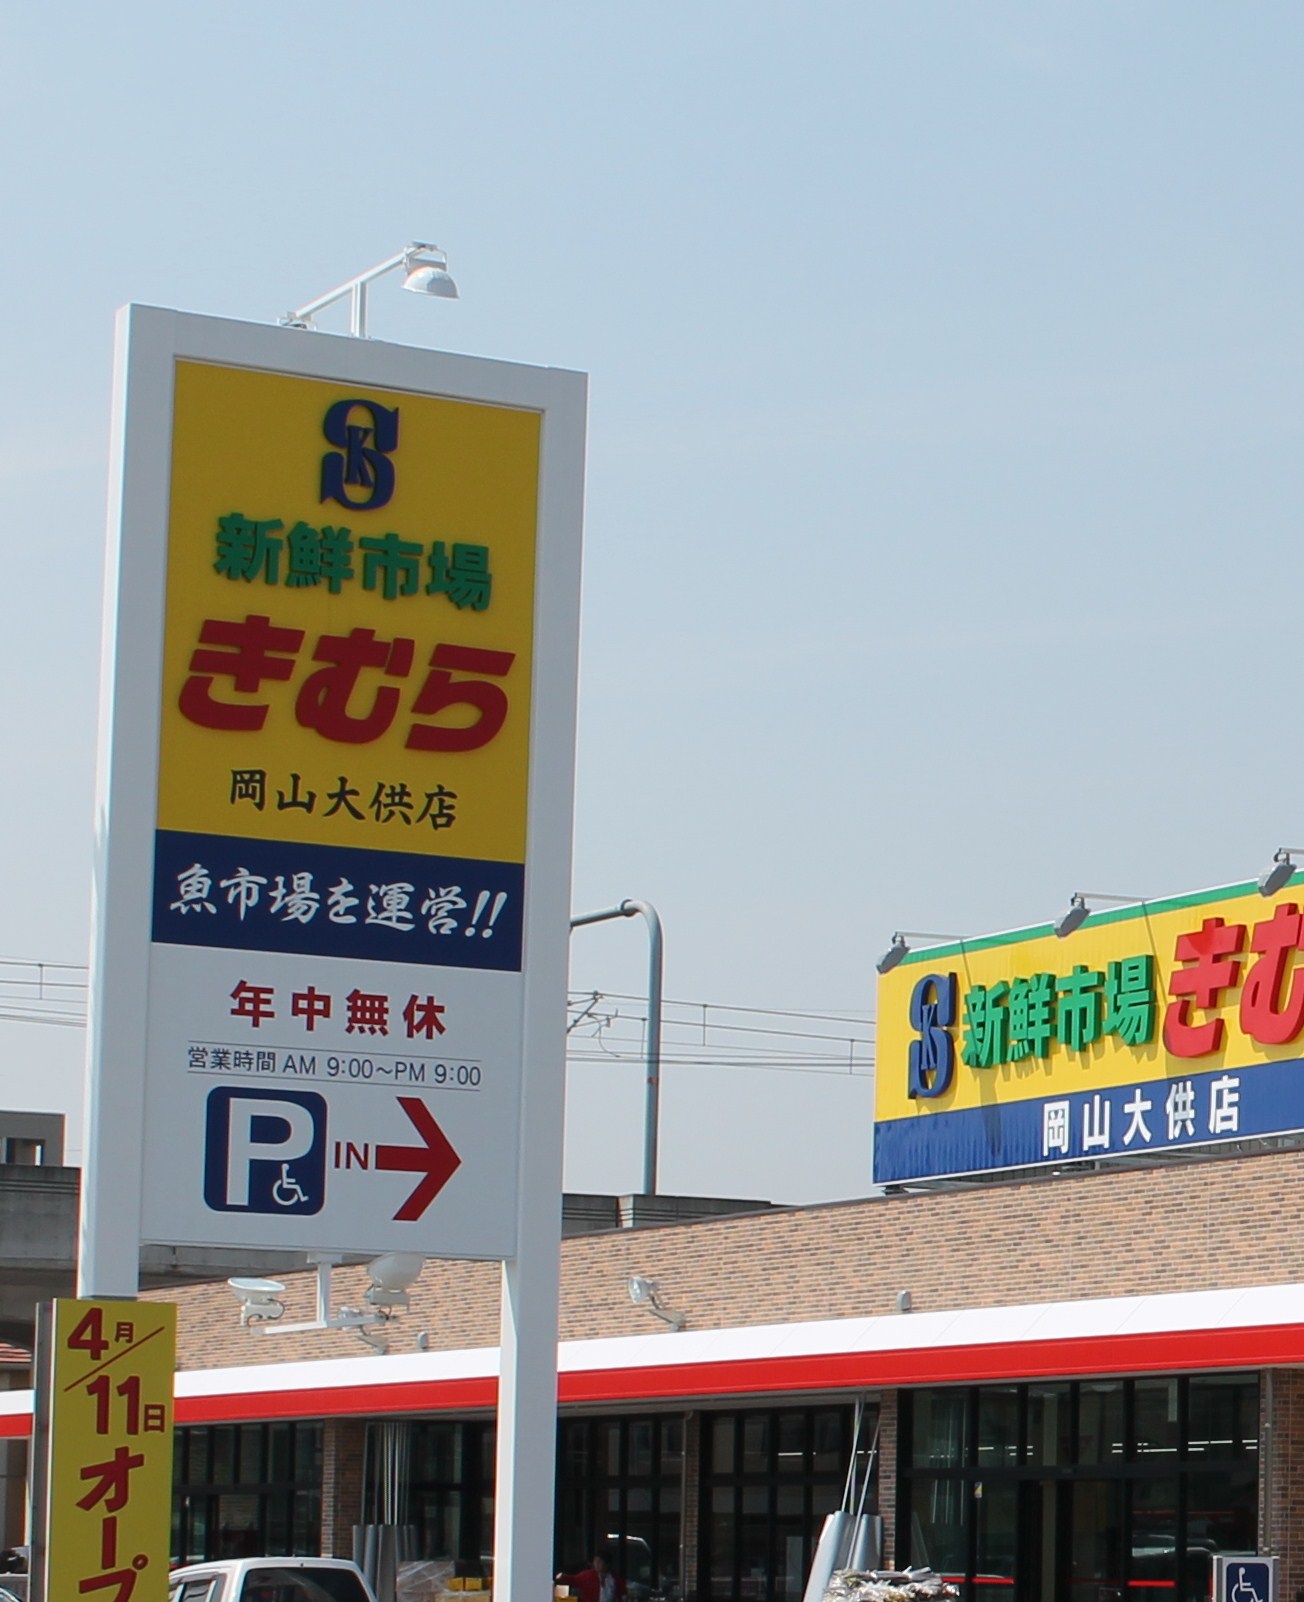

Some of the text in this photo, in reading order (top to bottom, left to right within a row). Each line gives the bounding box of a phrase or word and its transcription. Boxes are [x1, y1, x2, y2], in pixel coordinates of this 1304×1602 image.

[213, 512, 493, 612] 新鮮市場
[178, 614, 516, 753] きむら
[229, 768, 459, 831] 岡山大供店
[229, 980, 447, 1040] 年中無休
[960, 954, 1157, 1070] 新鮮市場
[187, 1046, 277, 1073] 営業時間
[282, 1055, 317, 1075] AM
[434, 1064, 482, 1086] 9:00
[1042, 1074, 1242, 1157] 岡山大供店
[333, 1142, 370, 1170] IN
